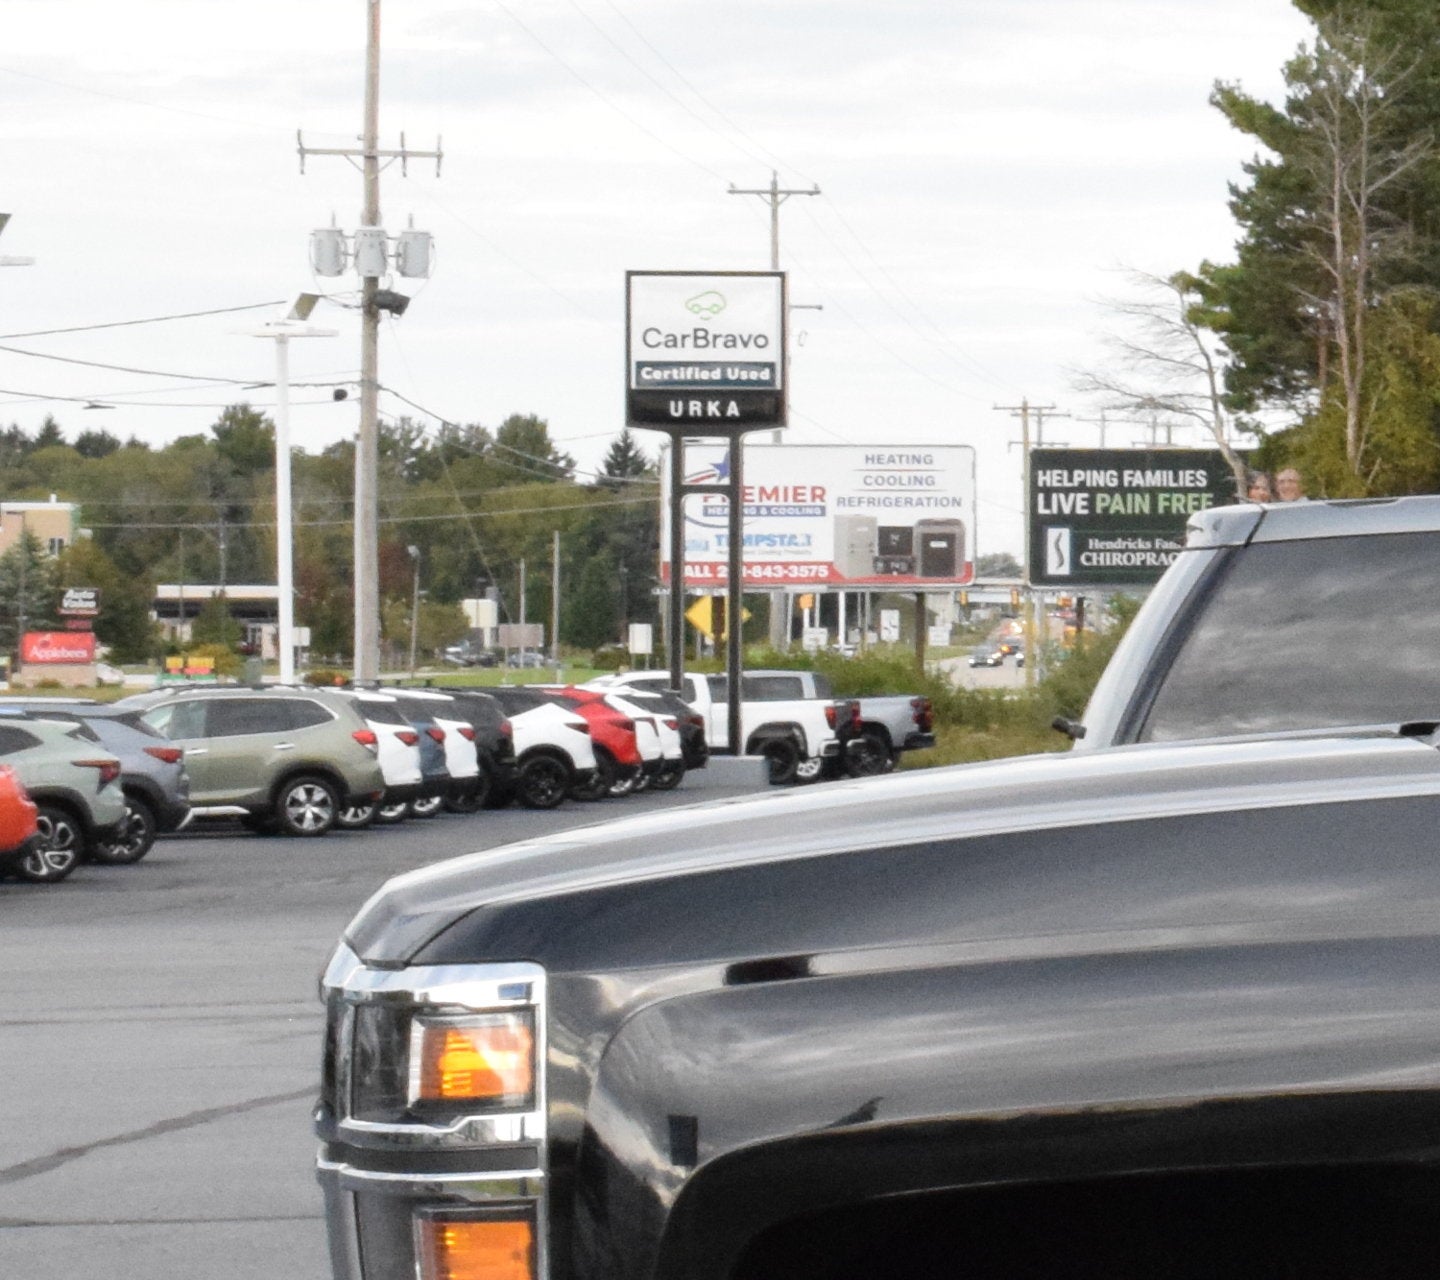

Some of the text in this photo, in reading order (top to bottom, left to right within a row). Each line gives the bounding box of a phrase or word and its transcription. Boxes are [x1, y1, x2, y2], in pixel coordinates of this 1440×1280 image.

[642, 327, 769, 349] CarBravo
[640, 367, 770, 380] Certified Used
[670, 400, 740, 417] URKA
[865, 454, 934, 465] HEATING
[863, 475, 935, 486] COOLING
[1037, 469, 1208, 488] HELPING FAMILIES
[703, 485, 826, 503] EMIER
[837, 496, 962, 508] REFRIGERATION
[1037, 492, 1214, 515] LIVE PAIN FREE
[707, 506, 757, 516] HEANG
[770, 506, 822, 516] COOLING
[1088, 538, 1152, 549] Hendricks
[684, 564, 829, 578] ALL 21-843-3575
